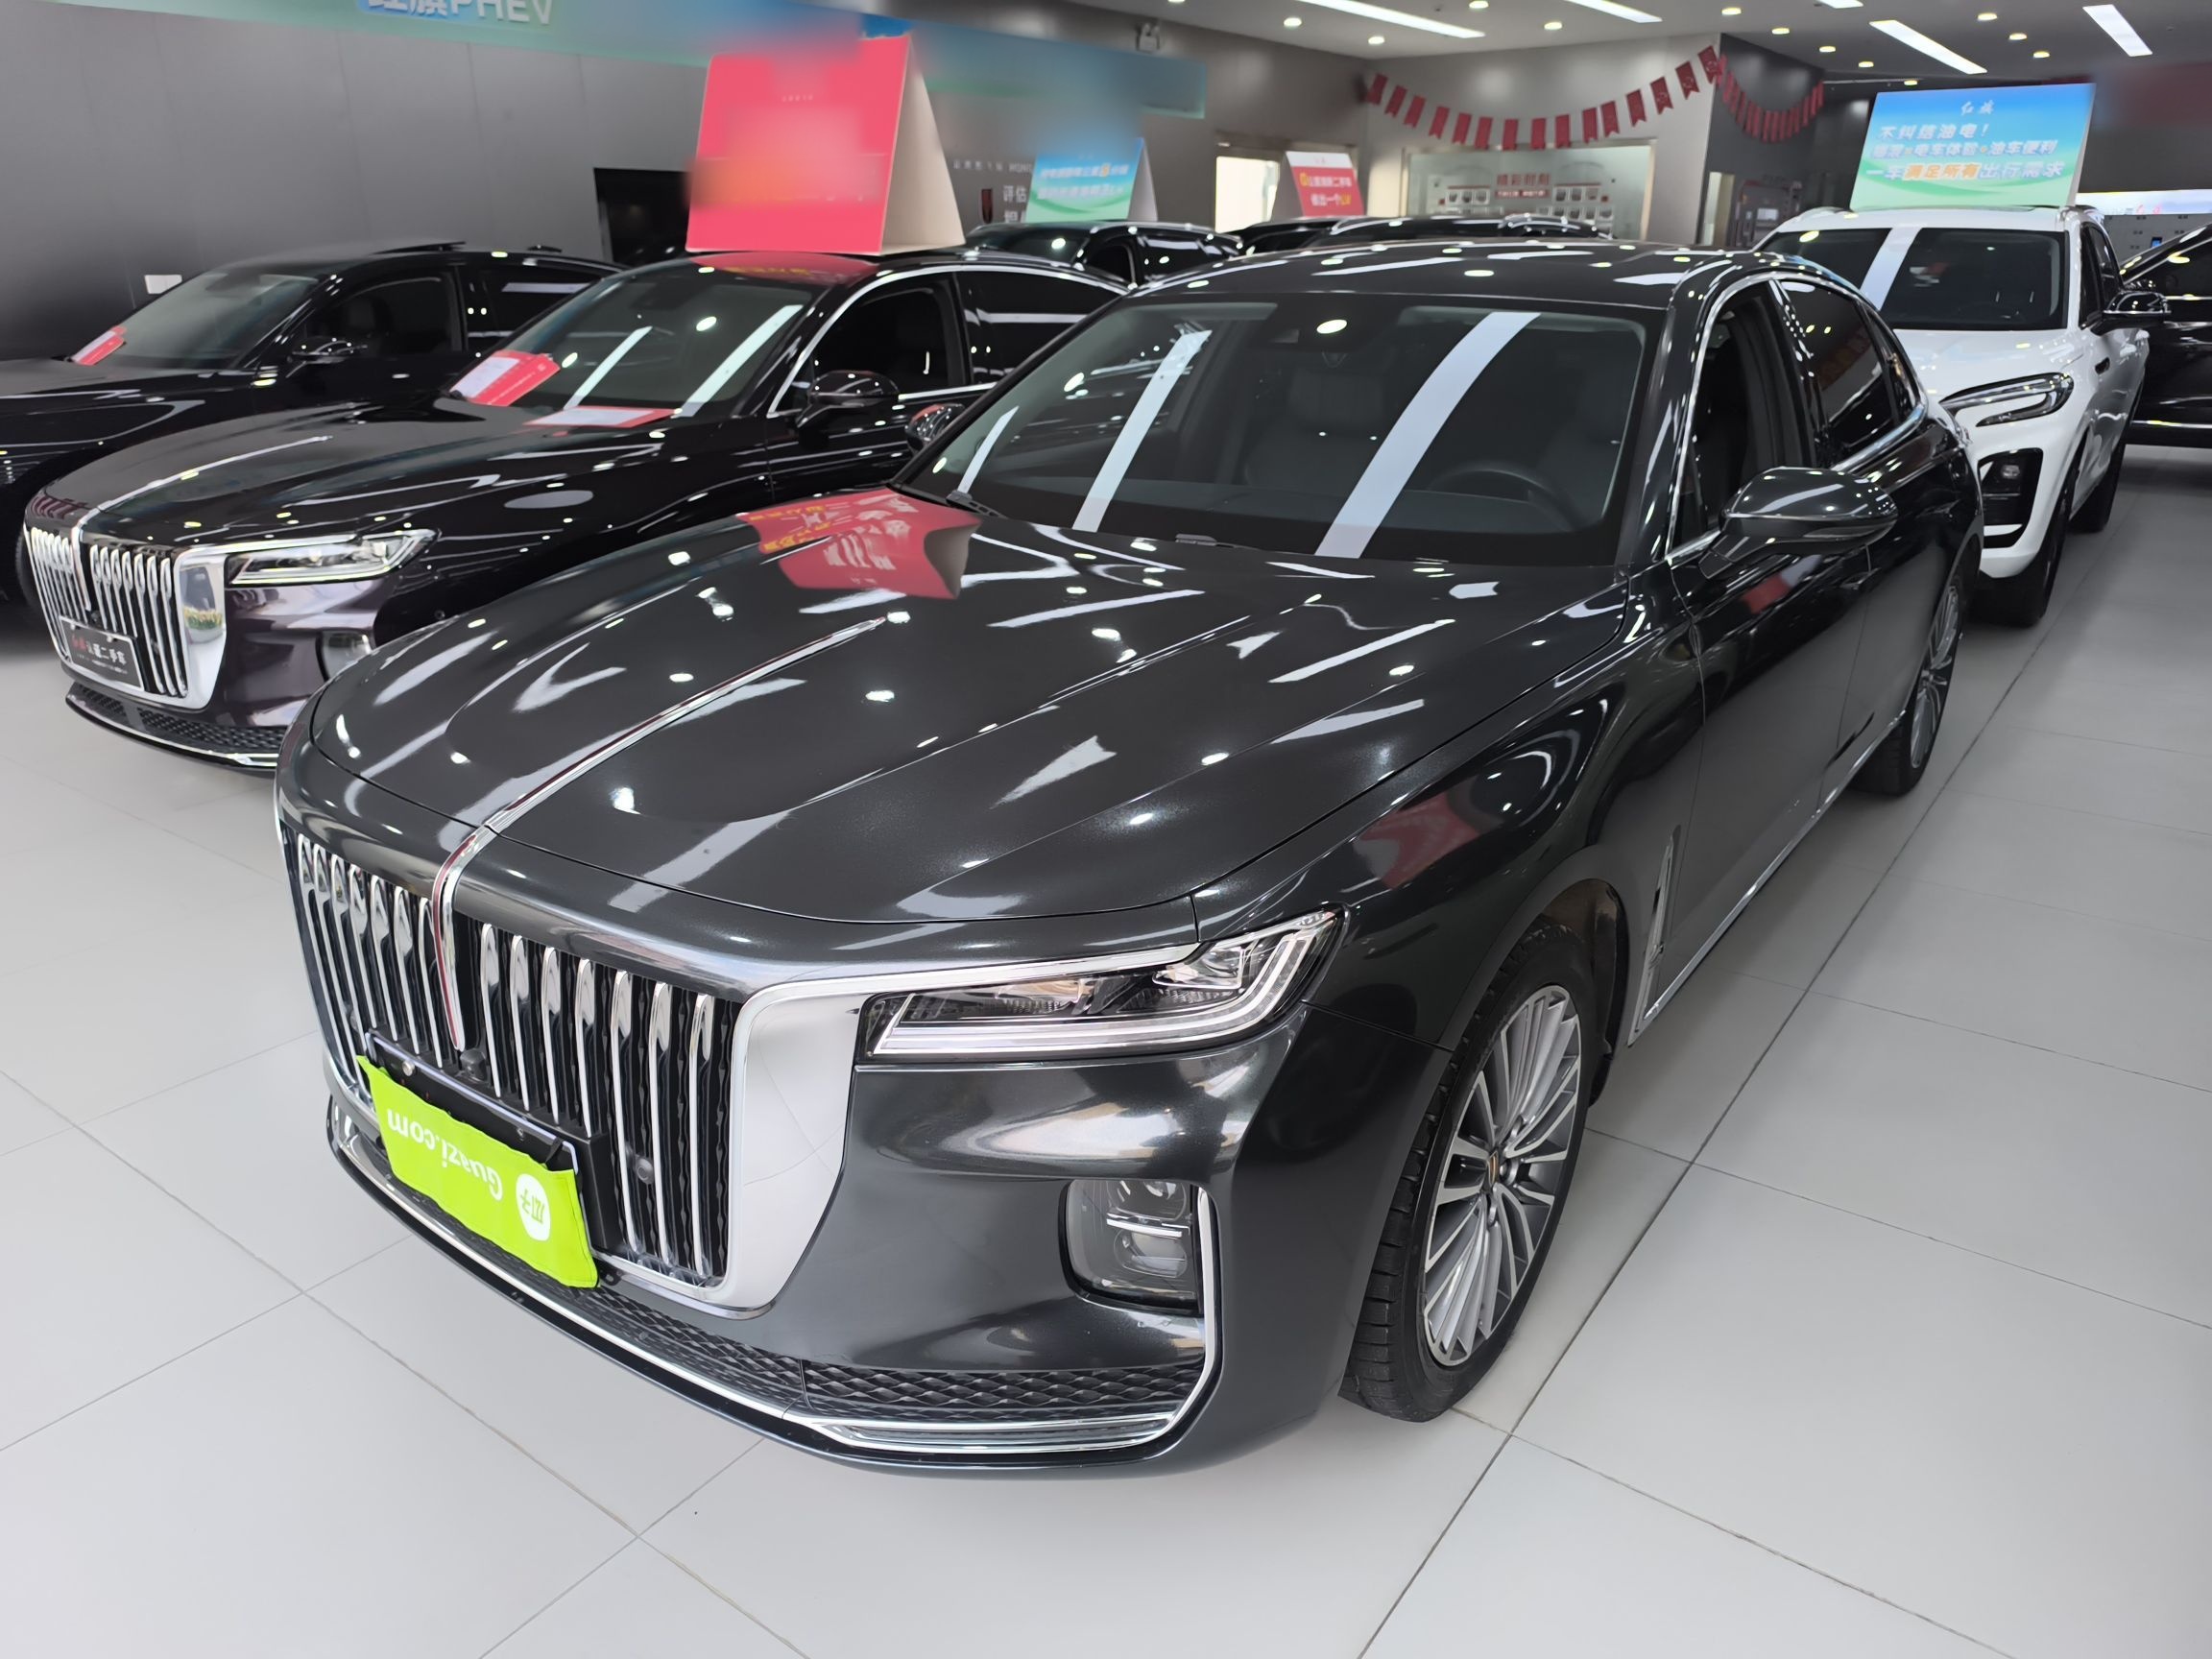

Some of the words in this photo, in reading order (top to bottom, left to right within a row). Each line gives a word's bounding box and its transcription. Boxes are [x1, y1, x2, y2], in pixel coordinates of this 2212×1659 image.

[1865, 160, 2065, 181] 一车满足所有出行需求
[387, 1108, 504, 1202] Guazi.com
